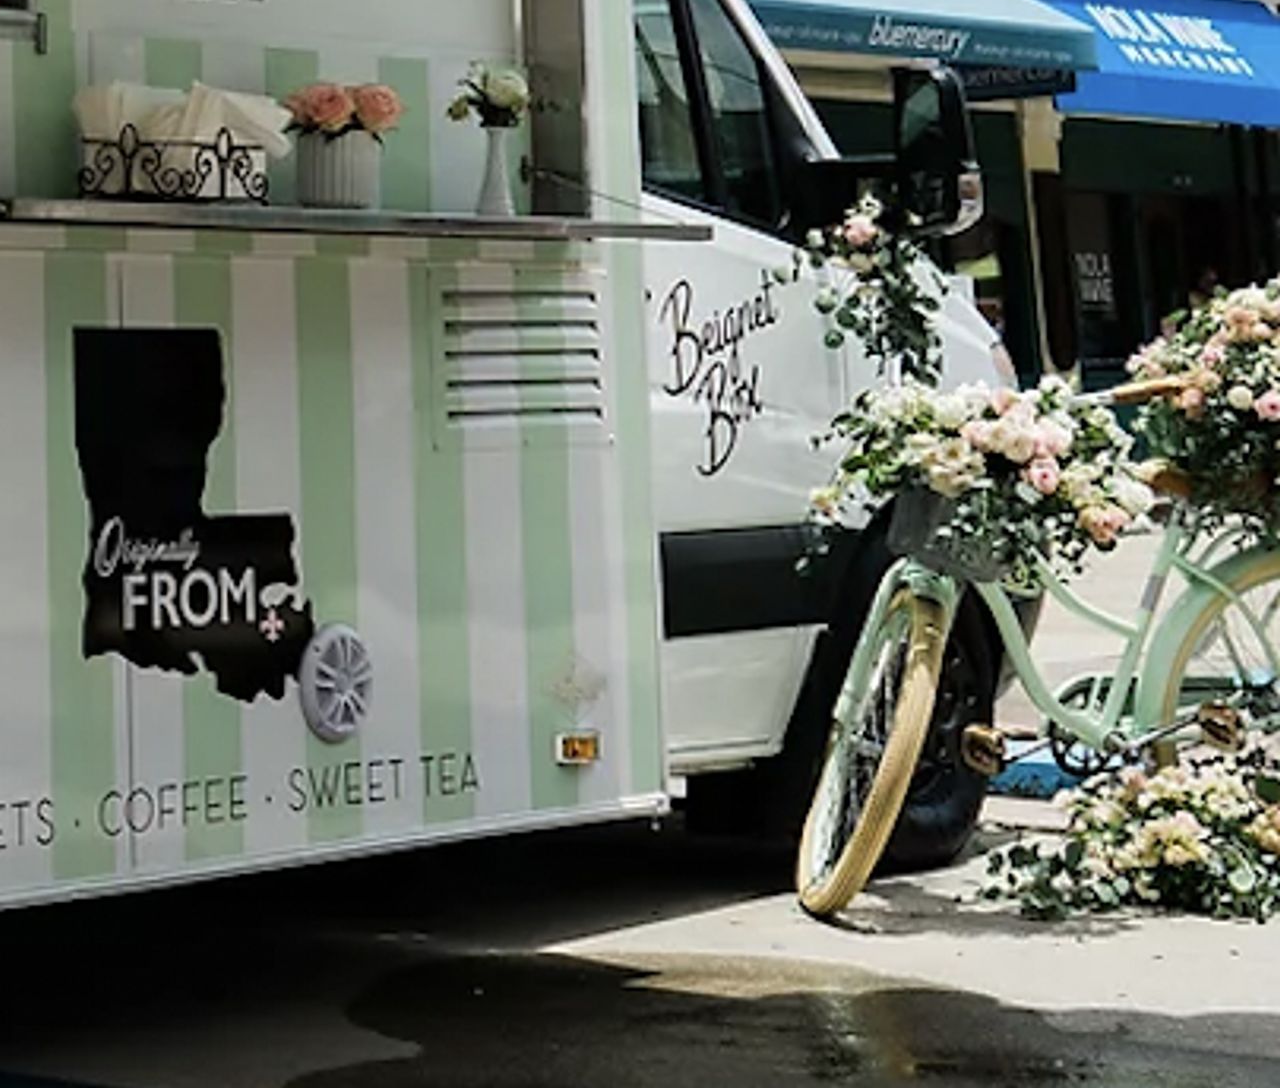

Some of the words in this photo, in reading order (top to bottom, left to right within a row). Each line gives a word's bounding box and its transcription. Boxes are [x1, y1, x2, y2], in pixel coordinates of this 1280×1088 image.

[868, 15, 972, 59] bluemercury
[1084, 1, 1172, 46] NOLA
[659, 268, 777, 396] Beignet
[695, 361, 762, 476] Box
[94, 515, 200, 578] Originally
[122, 566, 257, 630] FROM
[98, 775, 249, 837] COFFEE
[288, 758, 405, 812] SWEET
[420, 753, 480, 796] TEA
